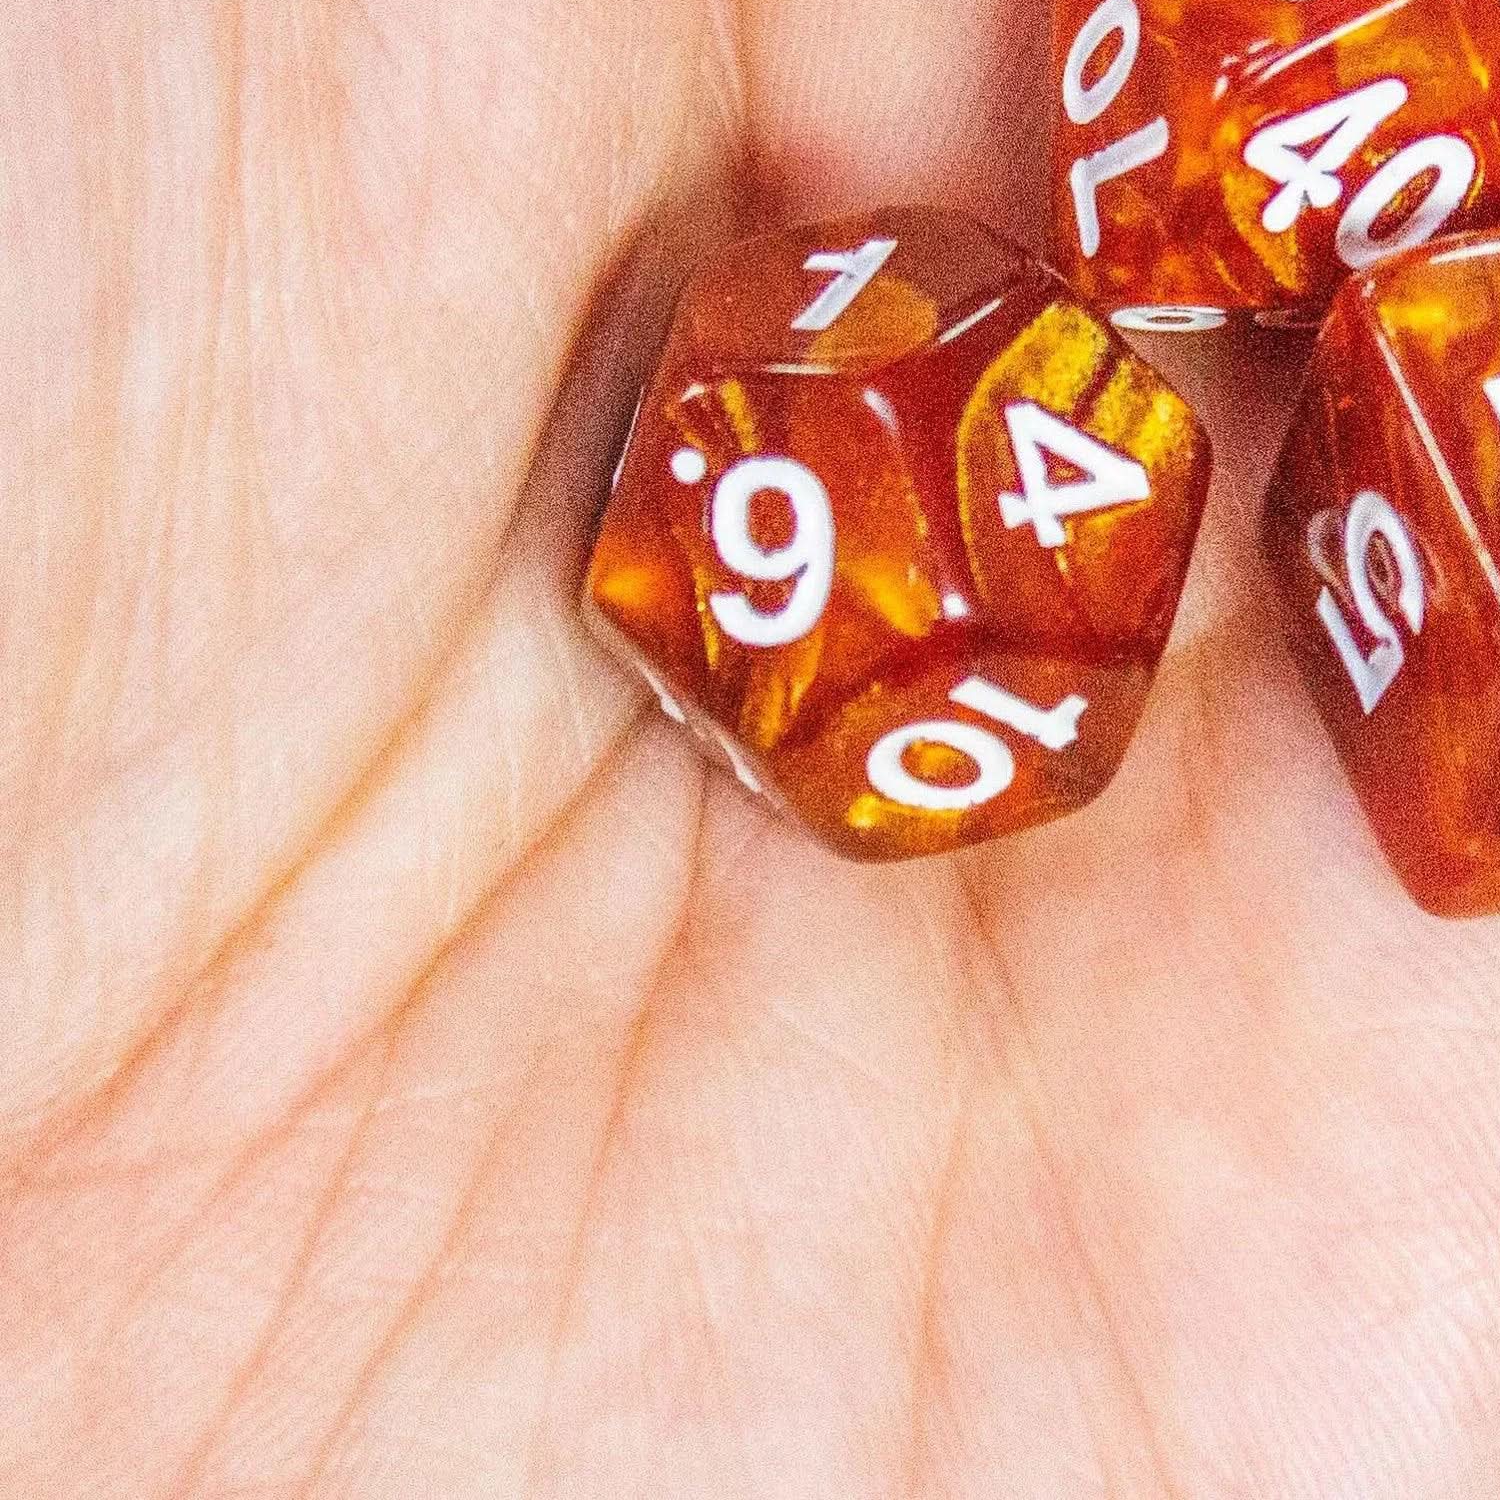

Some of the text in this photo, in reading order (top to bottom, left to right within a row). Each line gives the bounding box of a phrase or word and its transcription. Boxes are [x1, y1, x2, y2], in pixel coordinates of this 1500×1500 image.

[1242, 77, 1480, 270] 40
[789, 238, 899, 332] 1
[996, 401, 1152, 549] 4
[1315, 490, 1426, 716] 5
[865, 674, 1089, 812] 10
